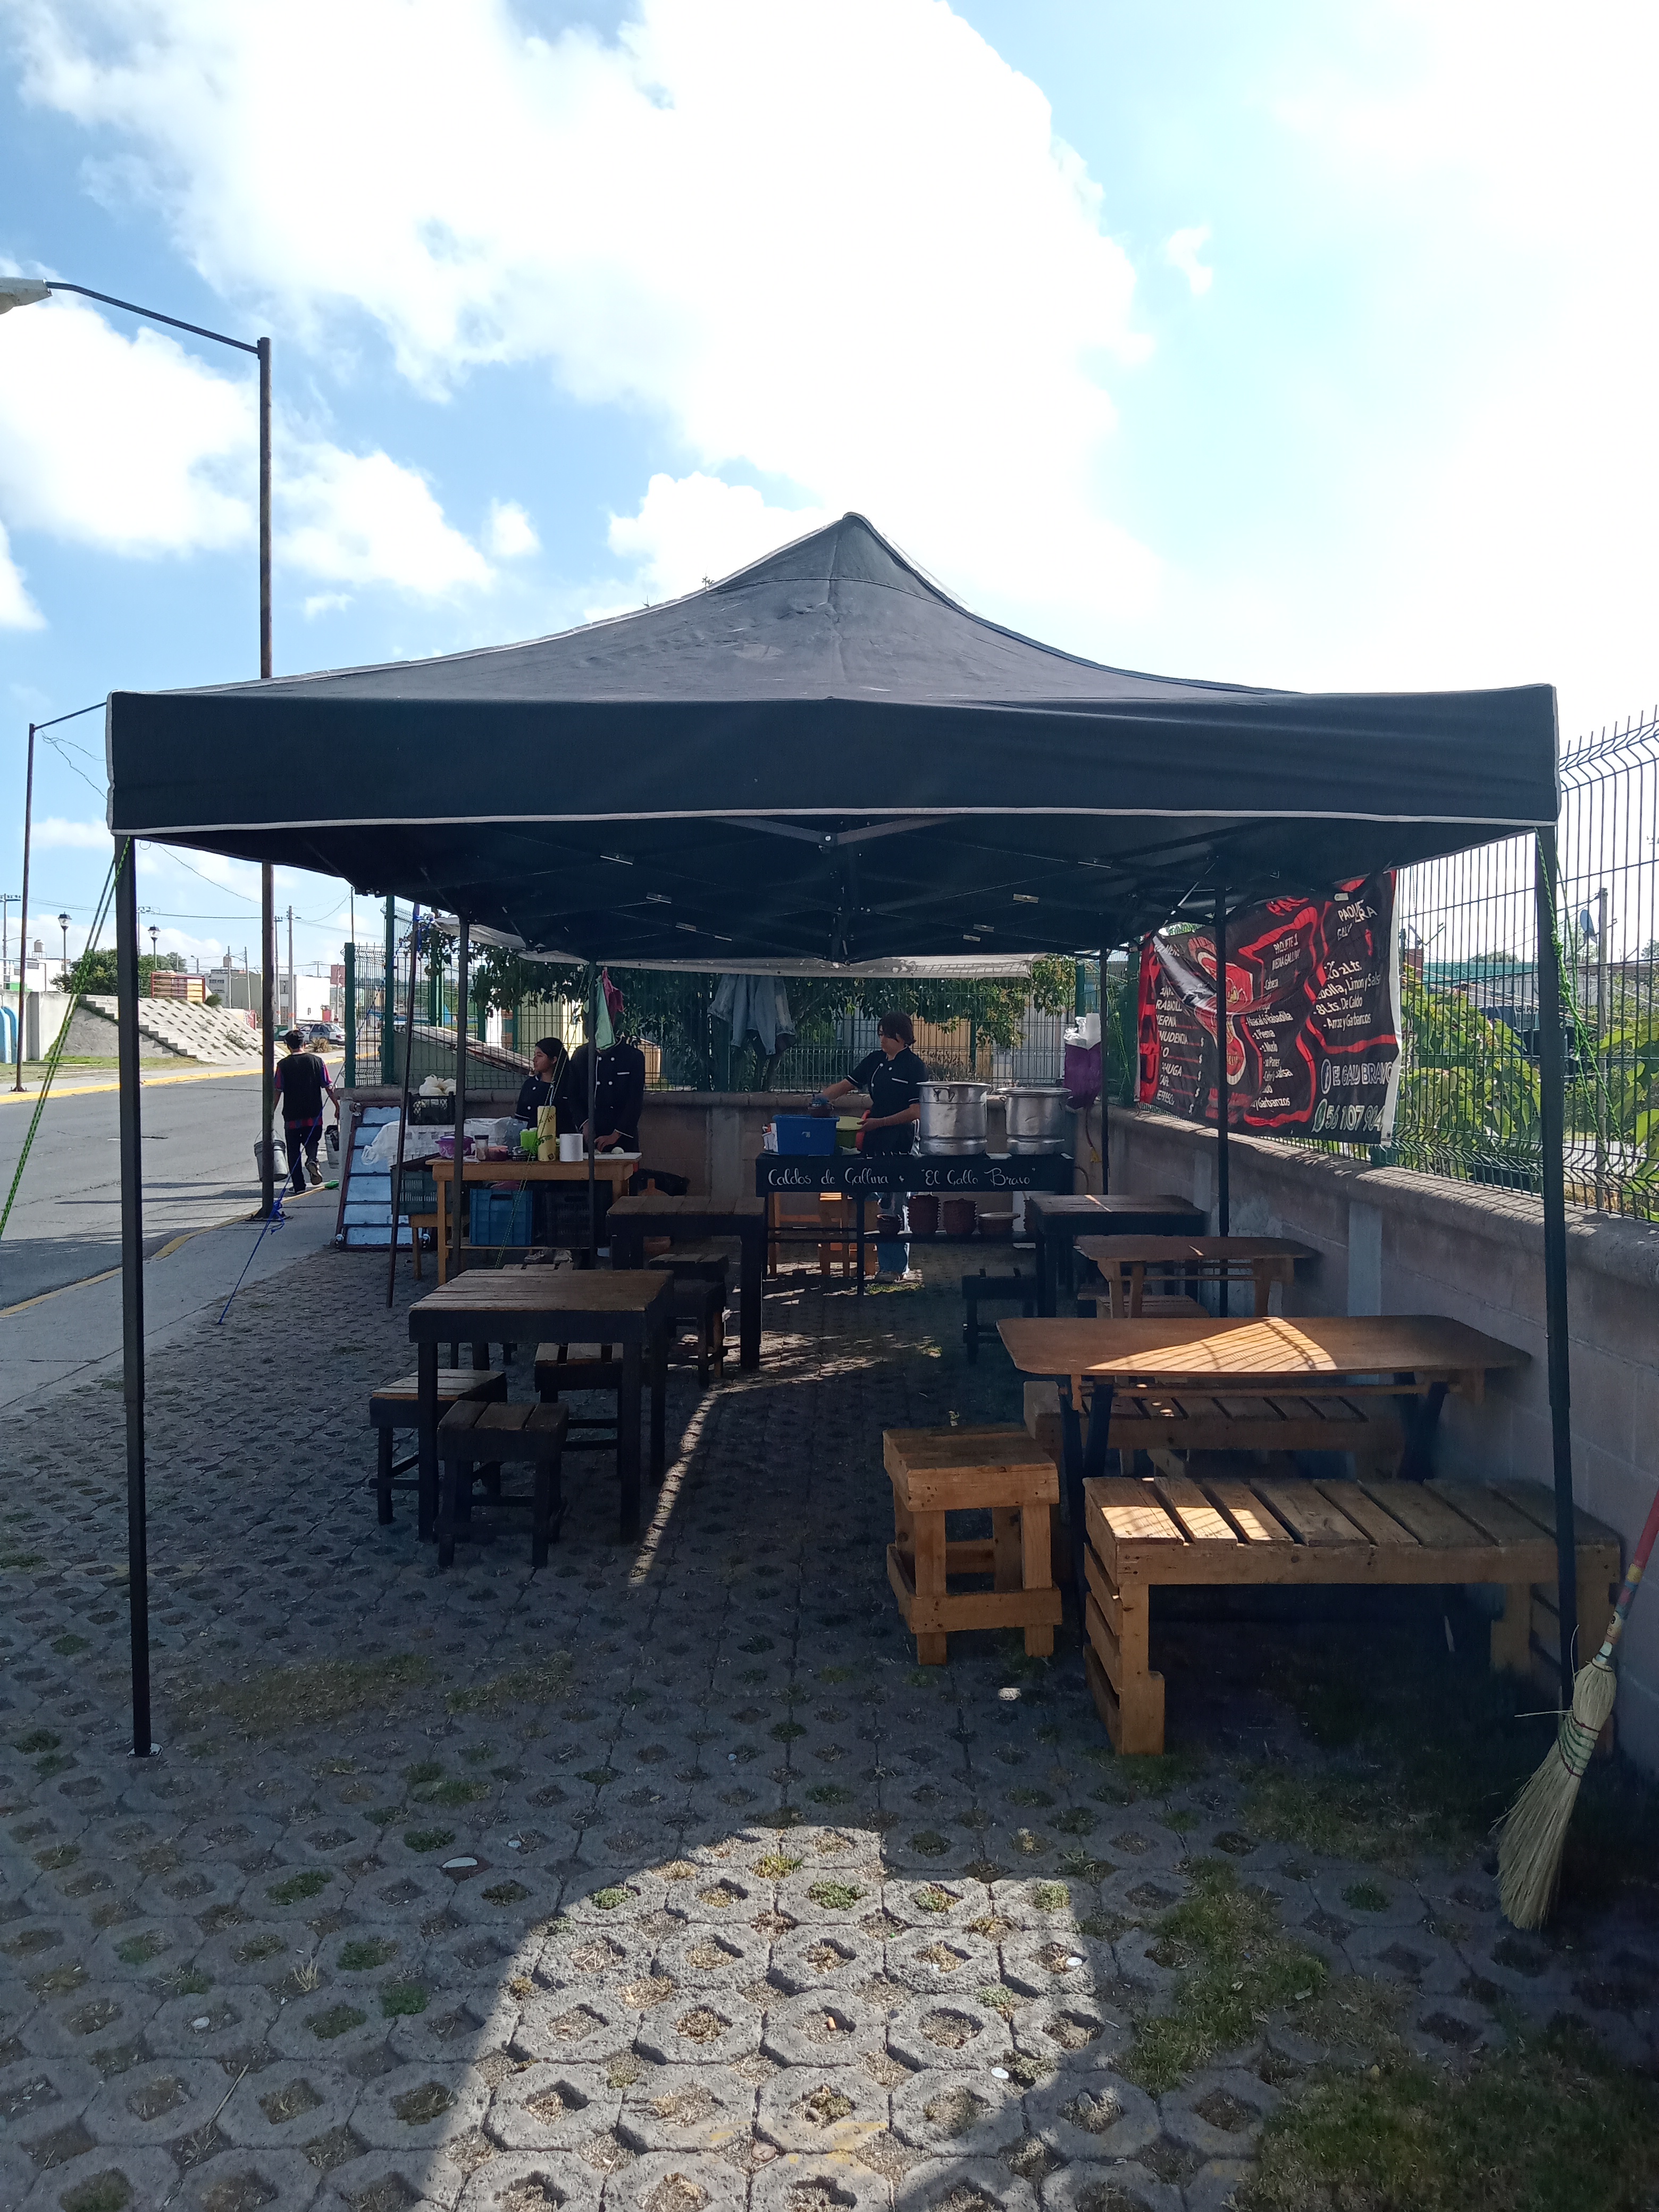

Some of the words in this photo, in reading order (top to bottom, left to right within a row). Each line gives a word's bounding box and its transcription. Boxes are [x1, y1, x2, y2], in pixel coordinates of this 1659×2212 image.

[1294, 933, 1298, 946] 1
[1349, 993, 1363, 1009] Caldo
[1343, 1018, 1346, 1032] y
[1361, 1061, 1393, 1085] BRAVO
[1258, 1096, 1291, 1108] Garbanzos
[768, 1168, 811, 1186] Caldos
[820, 1169, 836, 1185] de
[844, 1167, 889, 1186] Gallina
[946, 1169, 978, 1186] Gallo
